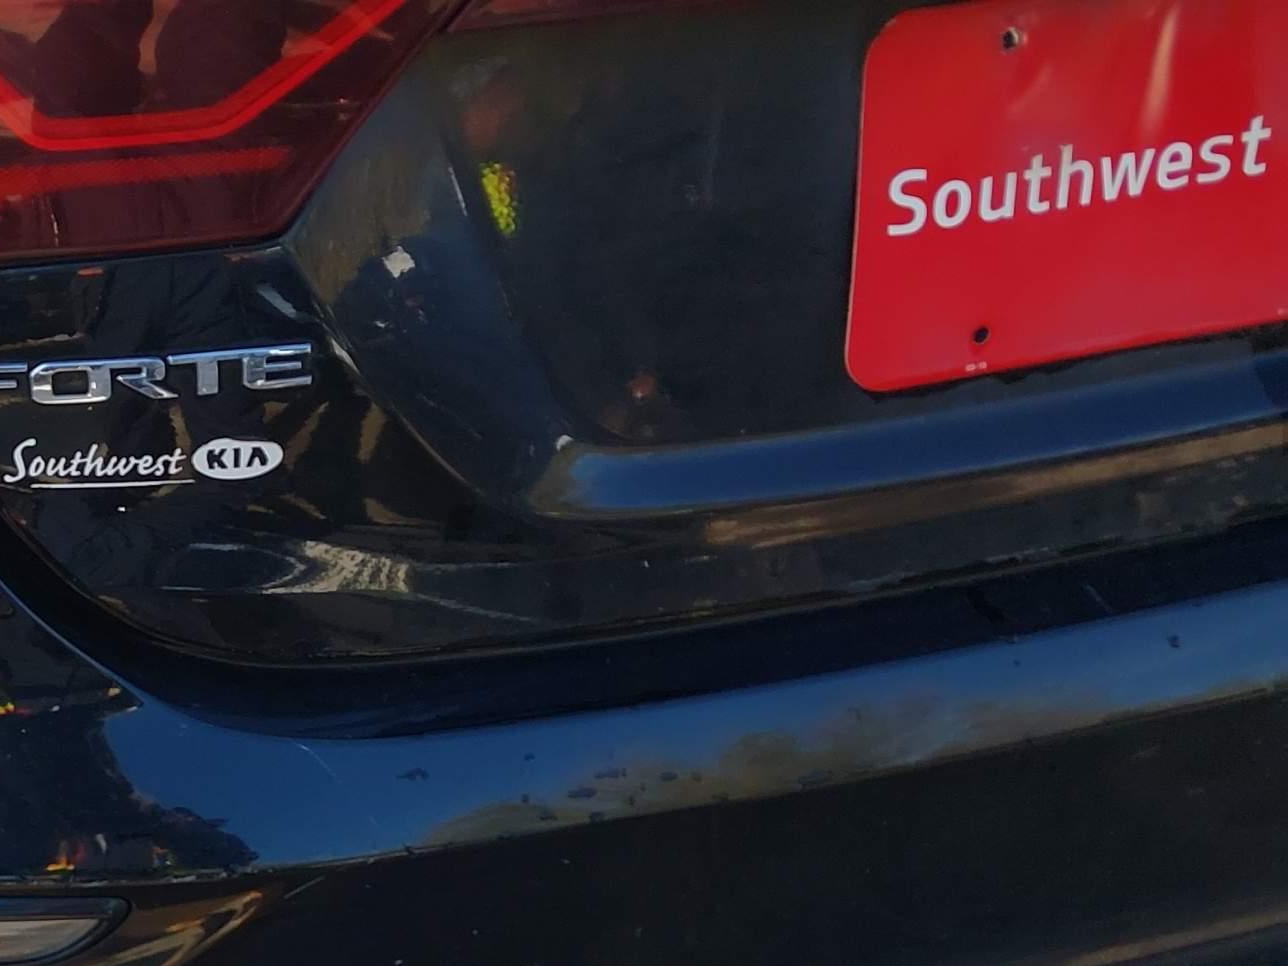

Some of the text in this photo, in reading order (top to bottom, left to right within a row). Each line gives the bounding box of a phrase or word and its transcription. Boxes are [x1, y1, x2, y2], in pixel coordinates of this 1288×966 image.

[887, 115, 1271, 236] Southwest
[3, 438, 269, 483] Southwest KIA
